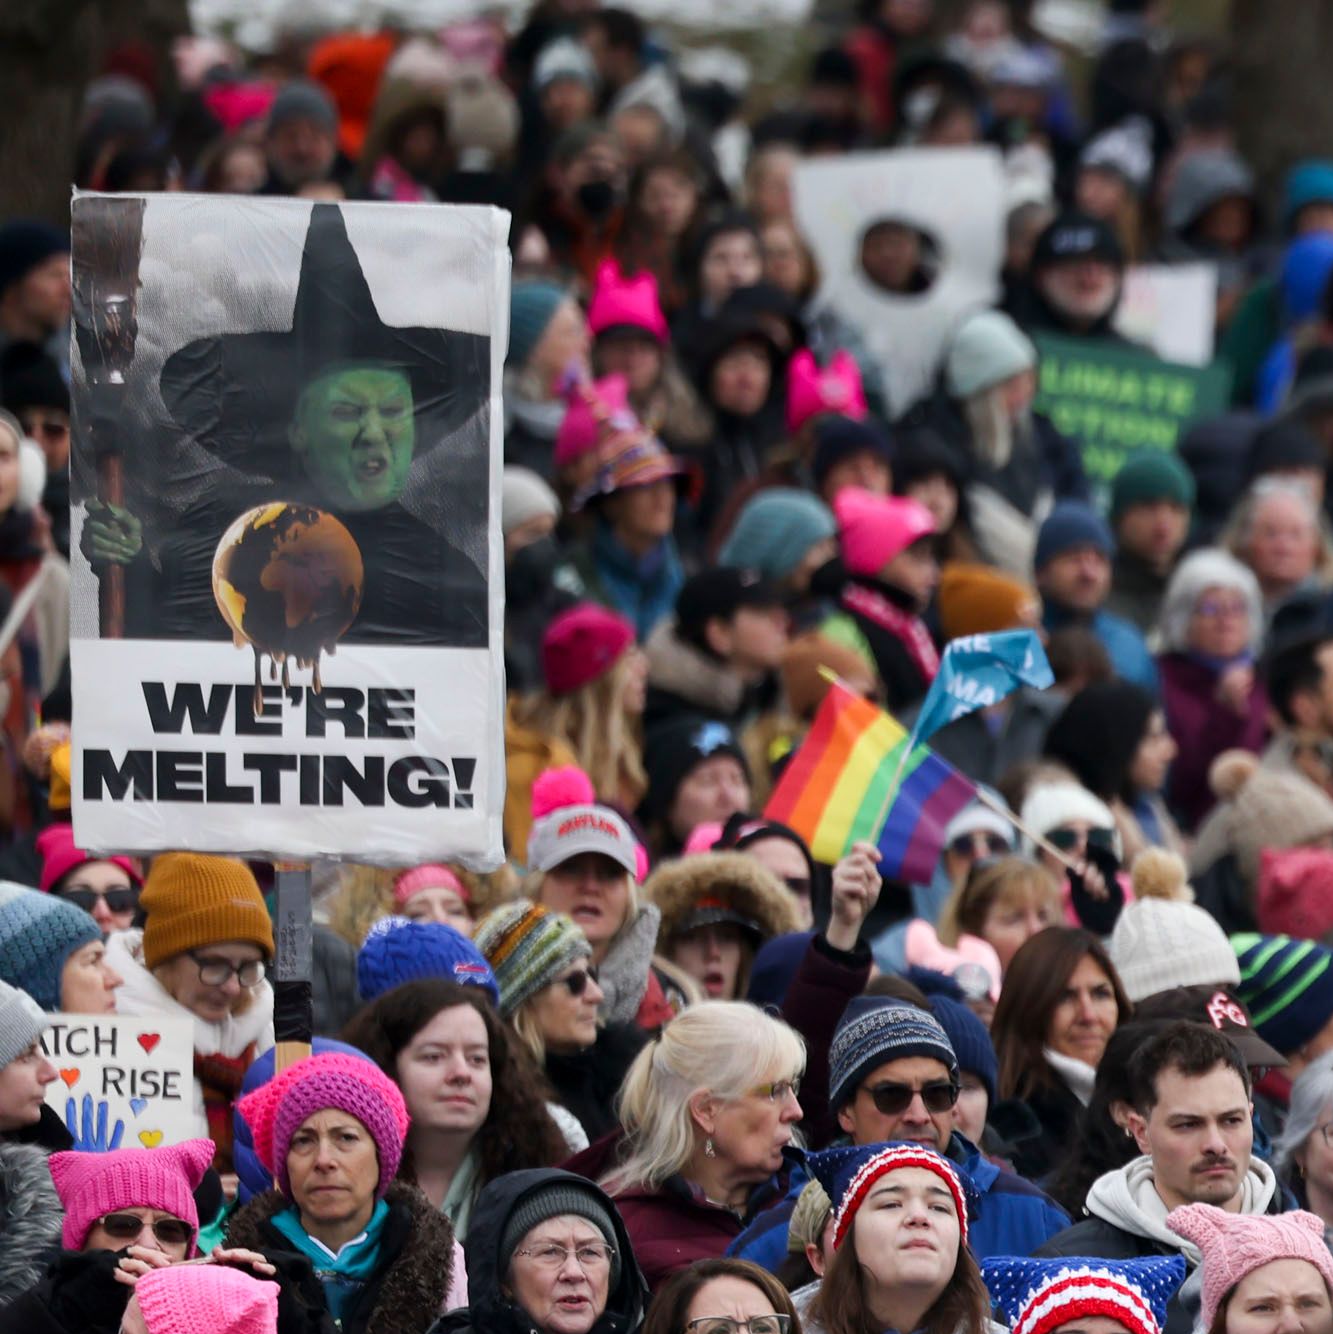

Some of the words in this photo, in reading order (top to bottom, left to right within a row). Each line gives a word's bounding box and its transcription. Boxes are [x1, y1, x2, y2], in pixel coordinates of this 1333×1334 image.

[141, 681, 416, 741] WE'RE
[82, 748, 477, 811] MELTING!
[102, 1066, 182, 1101] RISE
